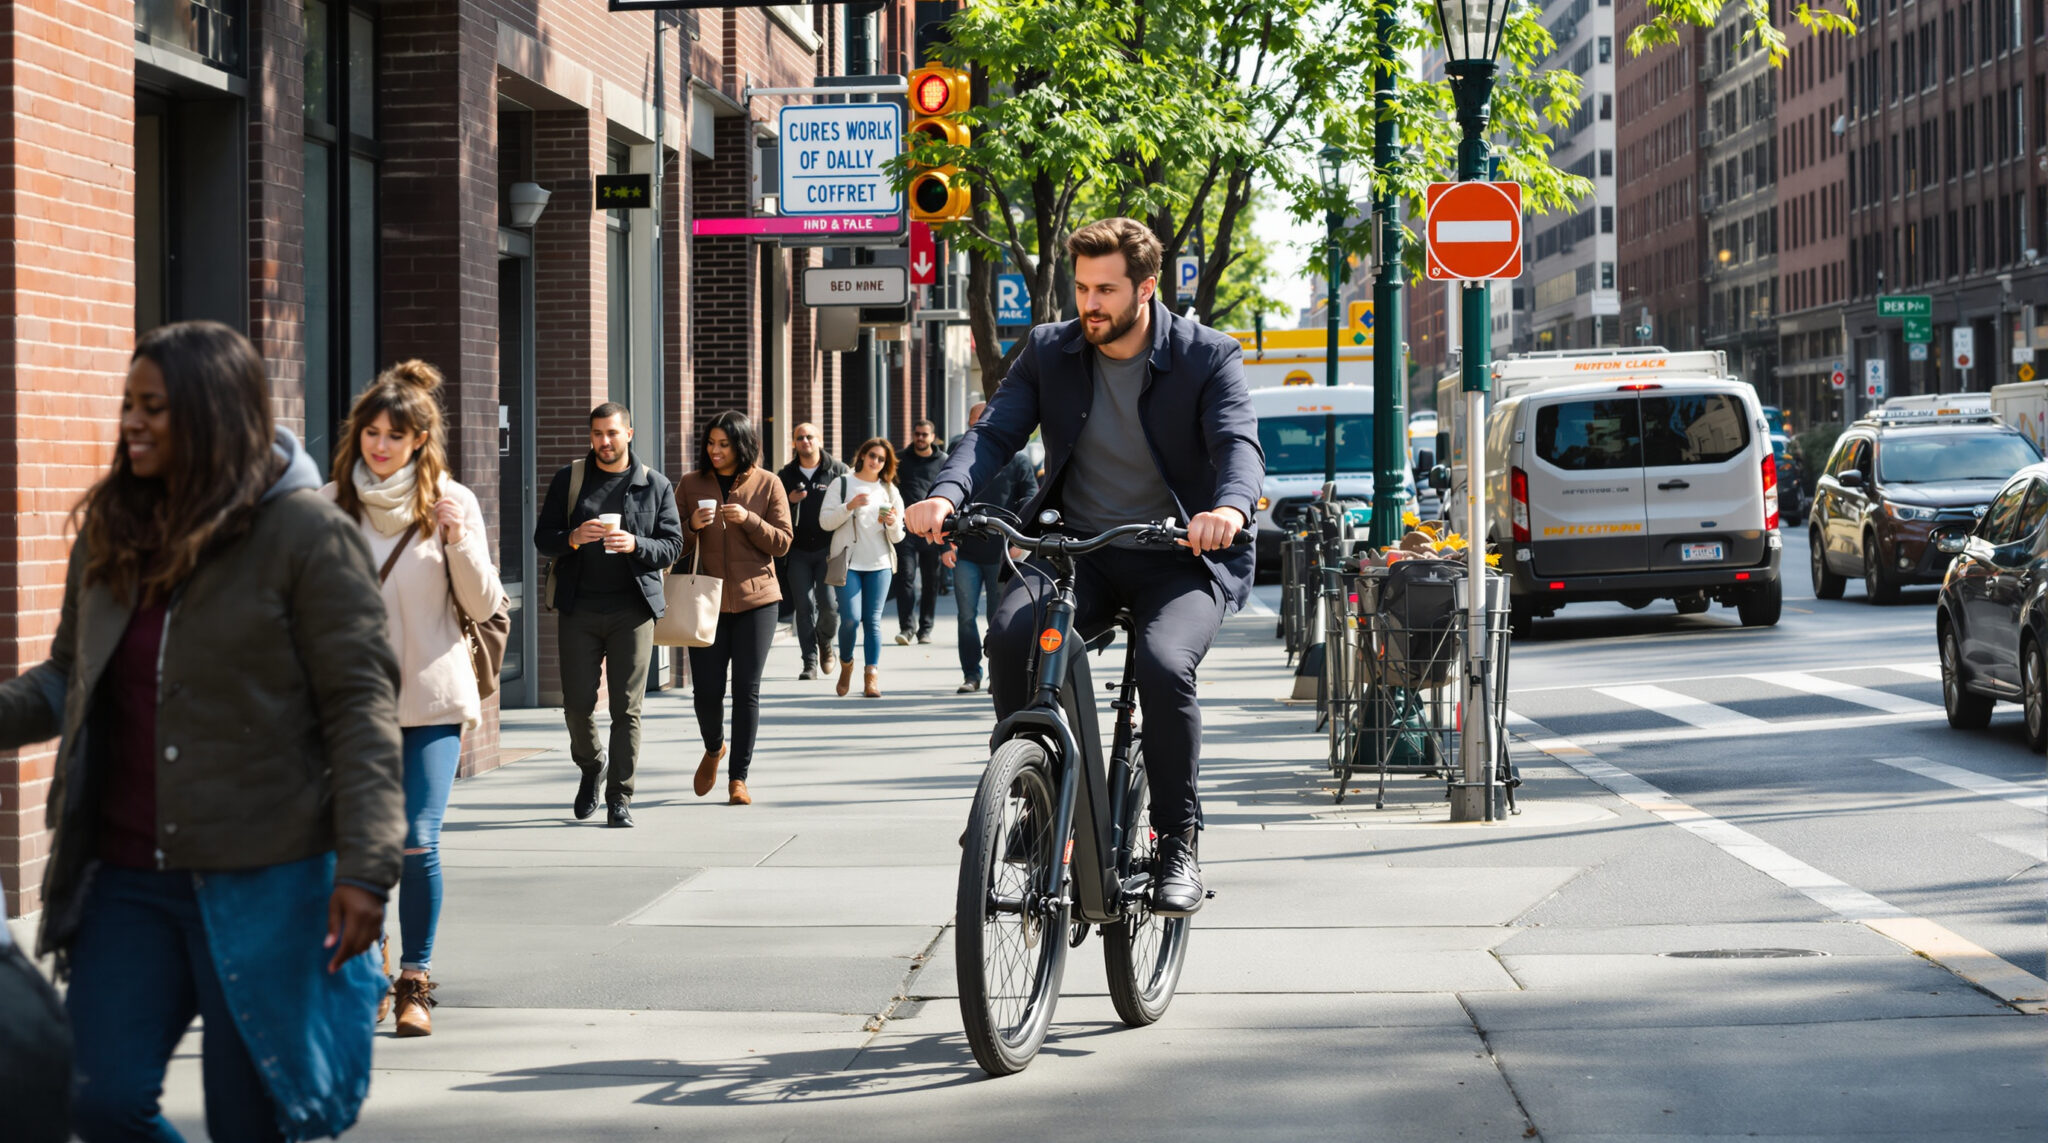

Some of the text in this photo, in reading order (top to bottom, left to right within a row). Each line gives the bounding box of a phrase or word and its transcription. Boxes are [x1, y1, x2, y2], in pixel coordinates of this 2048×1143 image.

[789, 120, 892, 142] CURES WORLK
[800, 149, 874, 170] OF DALLY
[807, 184, 877, 203] COFFRET
[1182, 263, 1197, 286] P
[830, 280, 852, 292] BED
